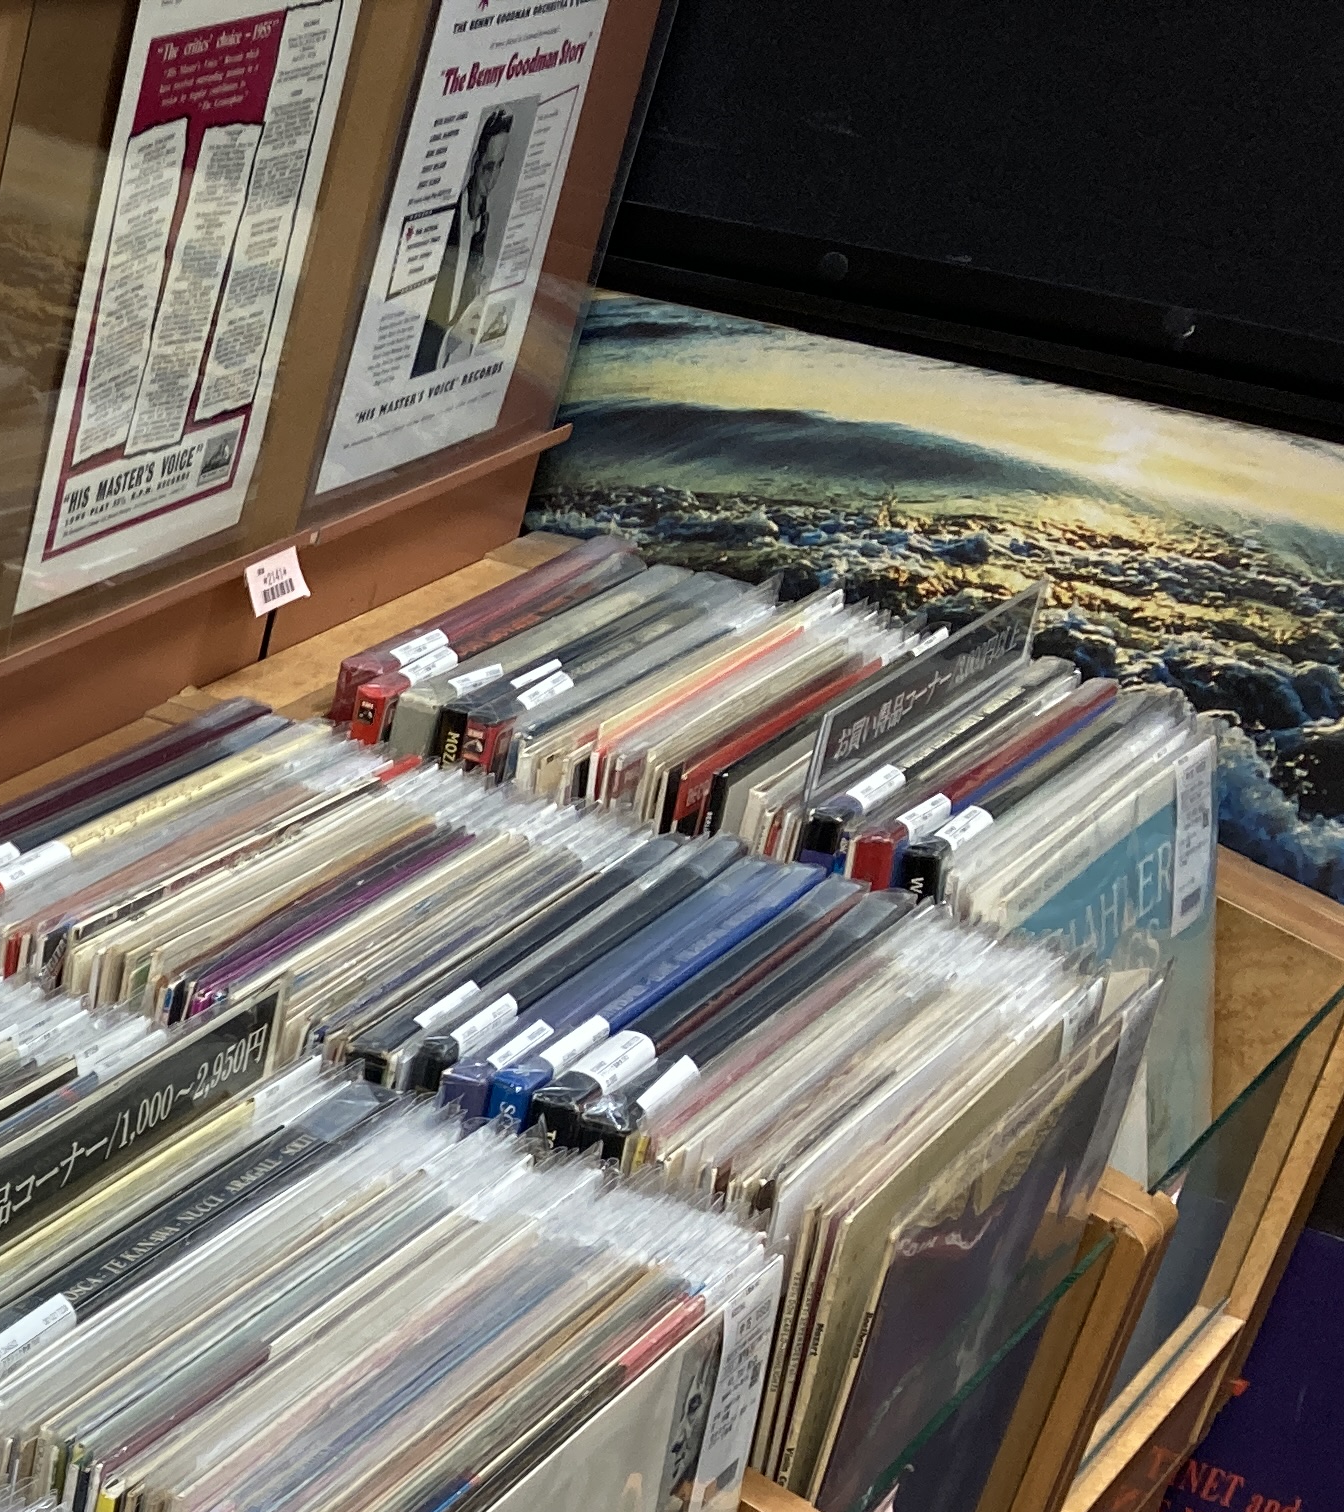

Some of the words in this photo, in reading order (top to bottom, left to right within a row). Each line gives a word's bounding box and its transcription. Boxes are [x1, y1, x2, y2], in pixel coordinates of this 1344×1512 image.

[466, 61, 506, 91] Benny
[506, 46, 560, 81] Goodman
[95, 460, 156, 503] MASTER'S
